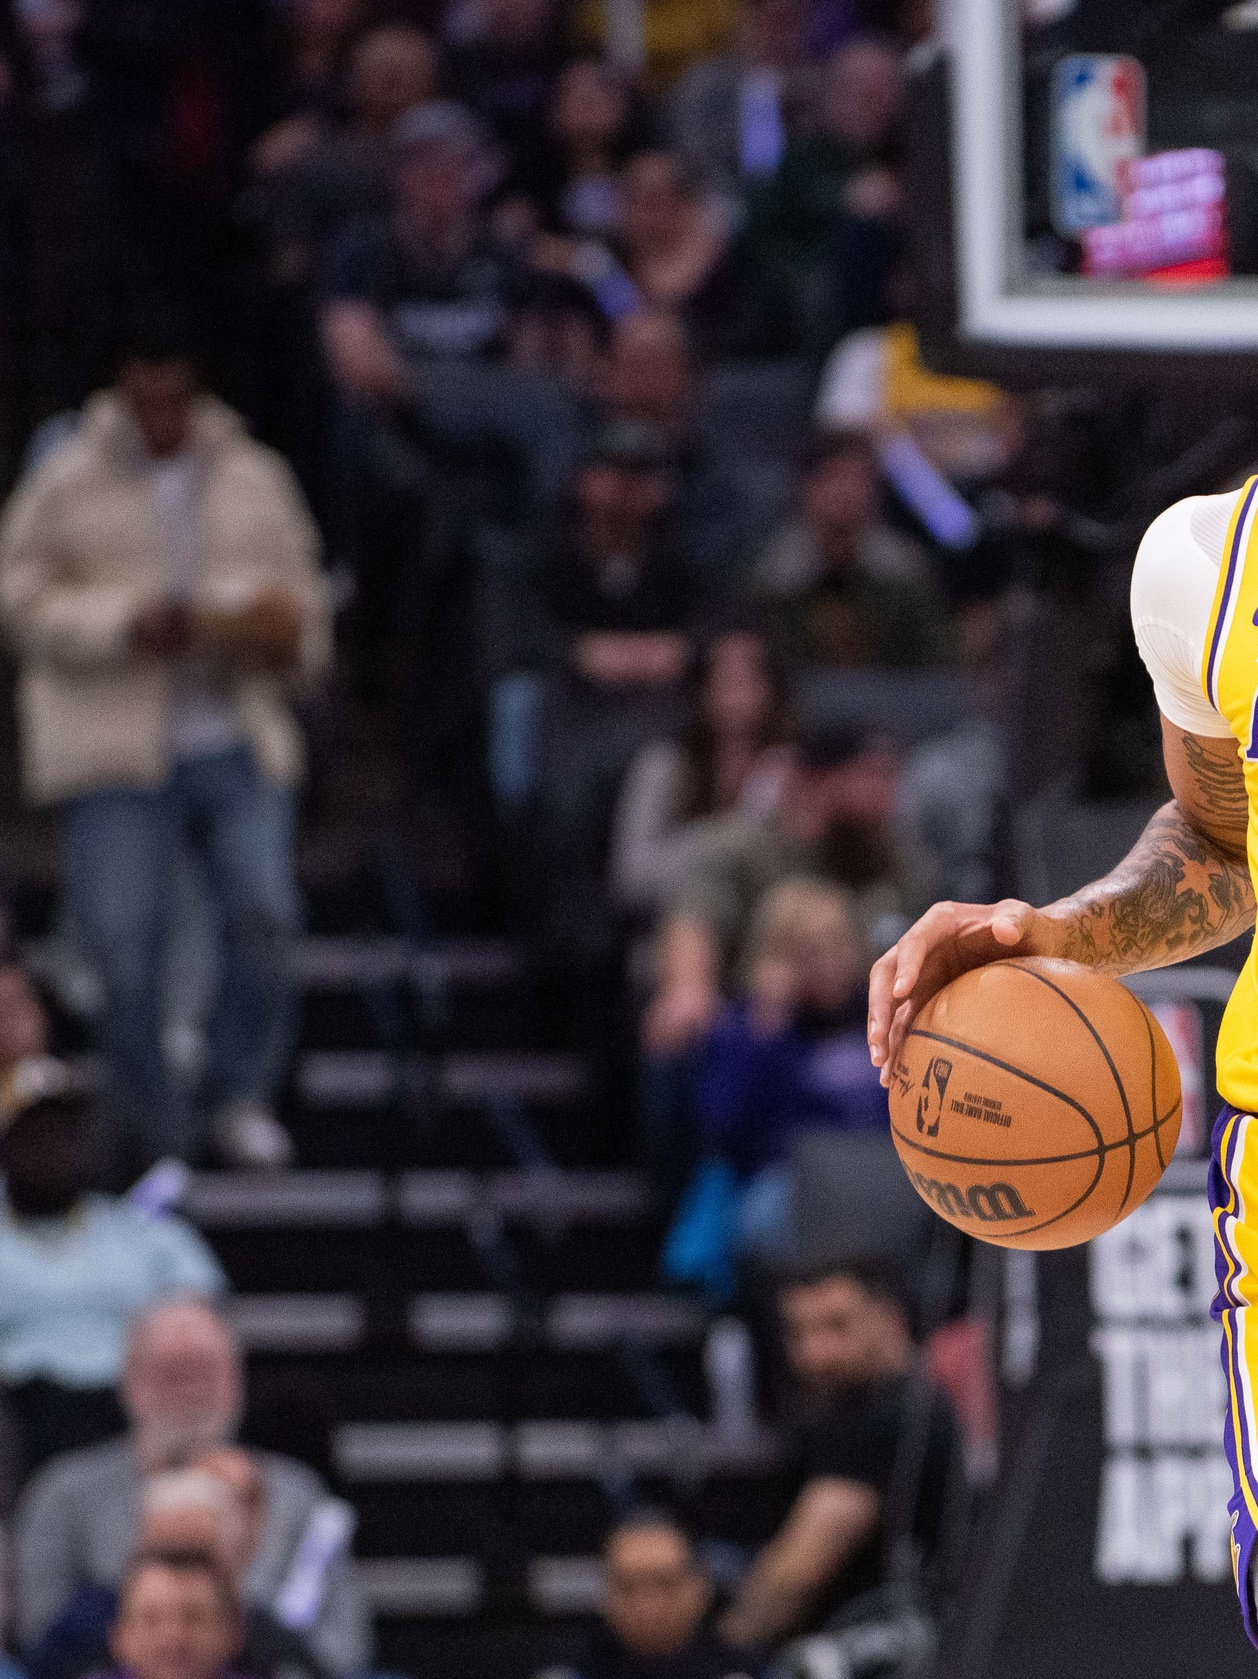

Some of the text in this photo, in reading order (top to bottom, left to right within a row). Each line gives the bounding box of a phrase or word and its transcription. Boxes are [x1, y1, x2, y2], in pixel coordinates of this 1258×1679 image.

[950, 1099, 1012, 1128] OFFICIAL GAME BALL
